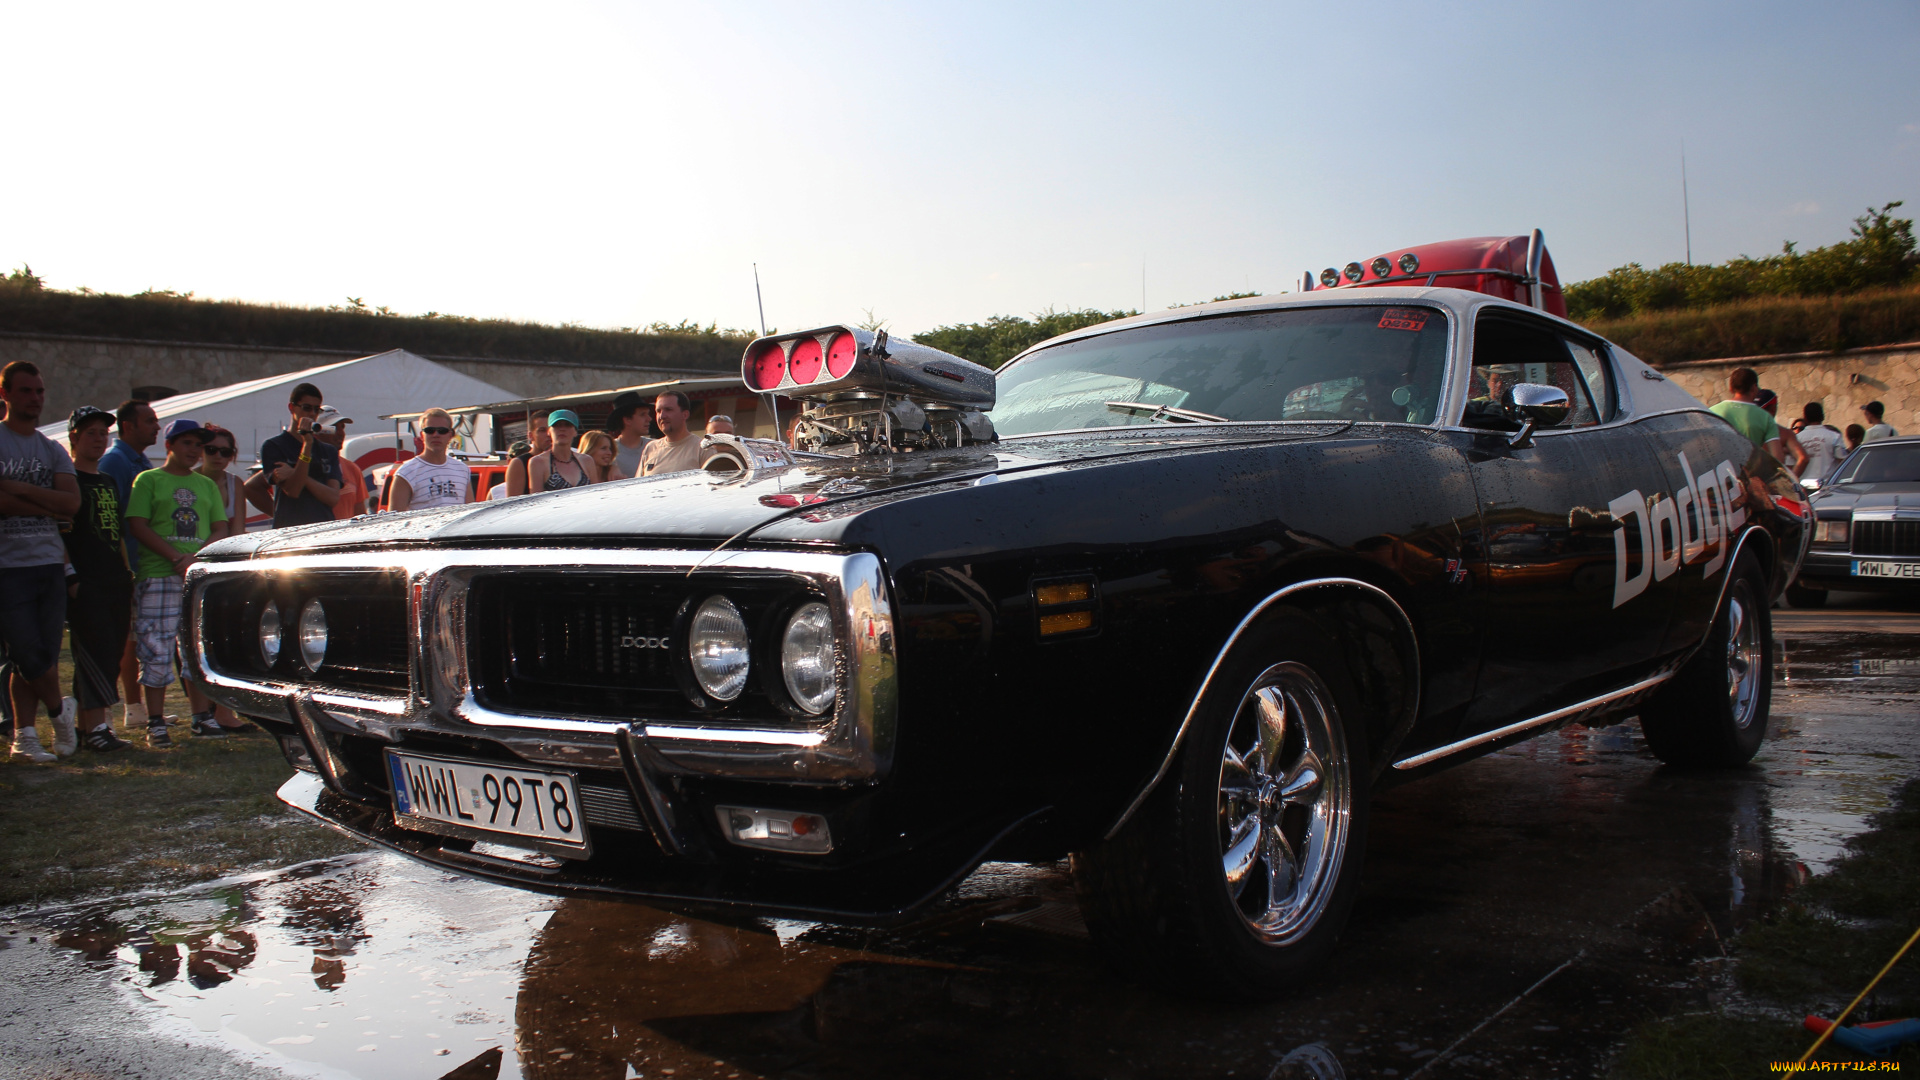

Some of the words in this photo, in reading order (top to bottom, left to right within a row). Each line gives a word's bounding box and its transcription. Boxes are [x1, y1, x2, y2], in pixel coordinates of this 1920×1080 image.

[1381, 319, 1420, 330] 0291
[1608, 451, 1746, 609] Dodge
[1444, 558, 1467, 584] R/T
[1860, 561, 1888, 576] WWL
[405, 762, 475, 821] WWL
[482, 773, 574, 833] 99T8
